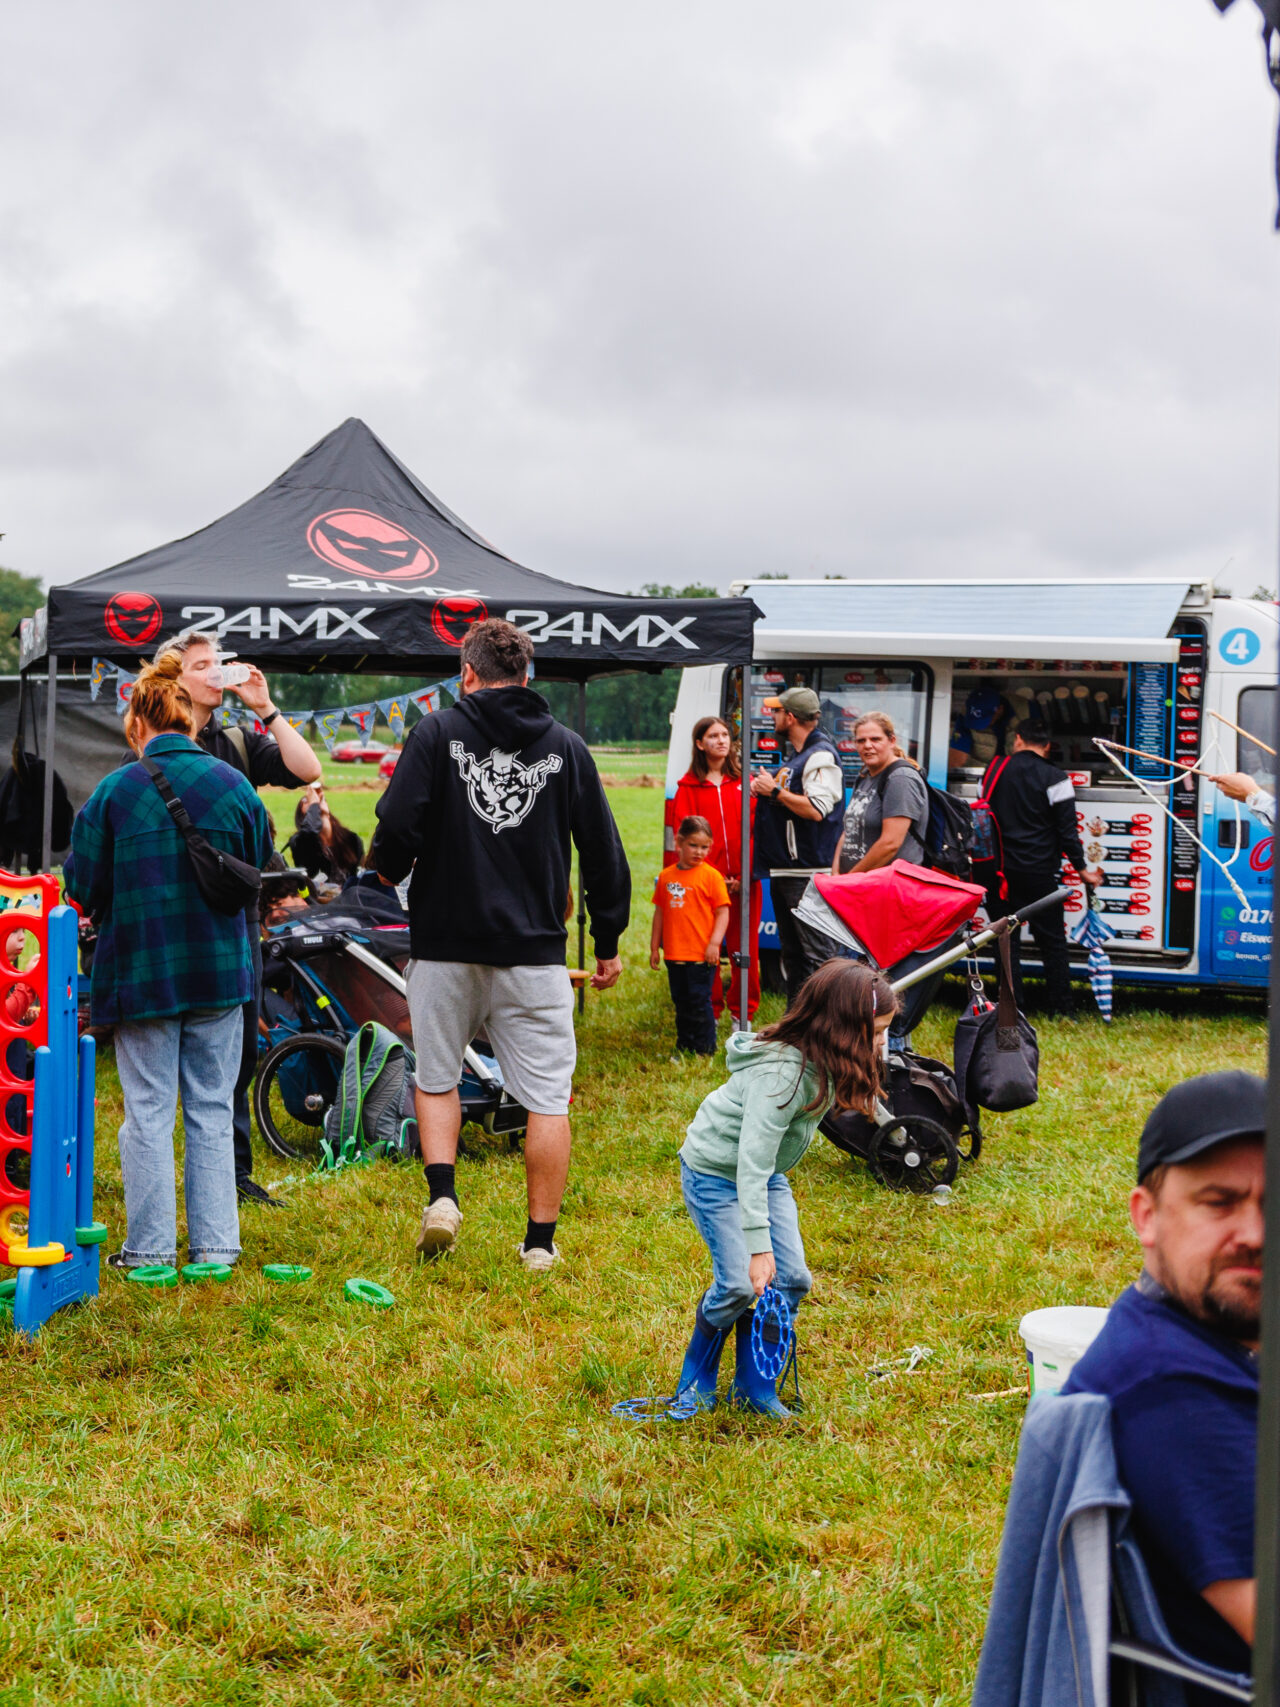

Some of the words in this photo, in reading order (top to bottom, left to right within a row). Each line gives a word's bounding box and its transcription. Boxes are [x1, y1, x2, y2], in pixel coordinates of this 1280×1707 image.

[286, 574, 492, 599] 24MX
[178, 606, 380, 640] 24MX
[506, 609, 701, 650] 24MX
[1226, 633, 1250, 660] 4
